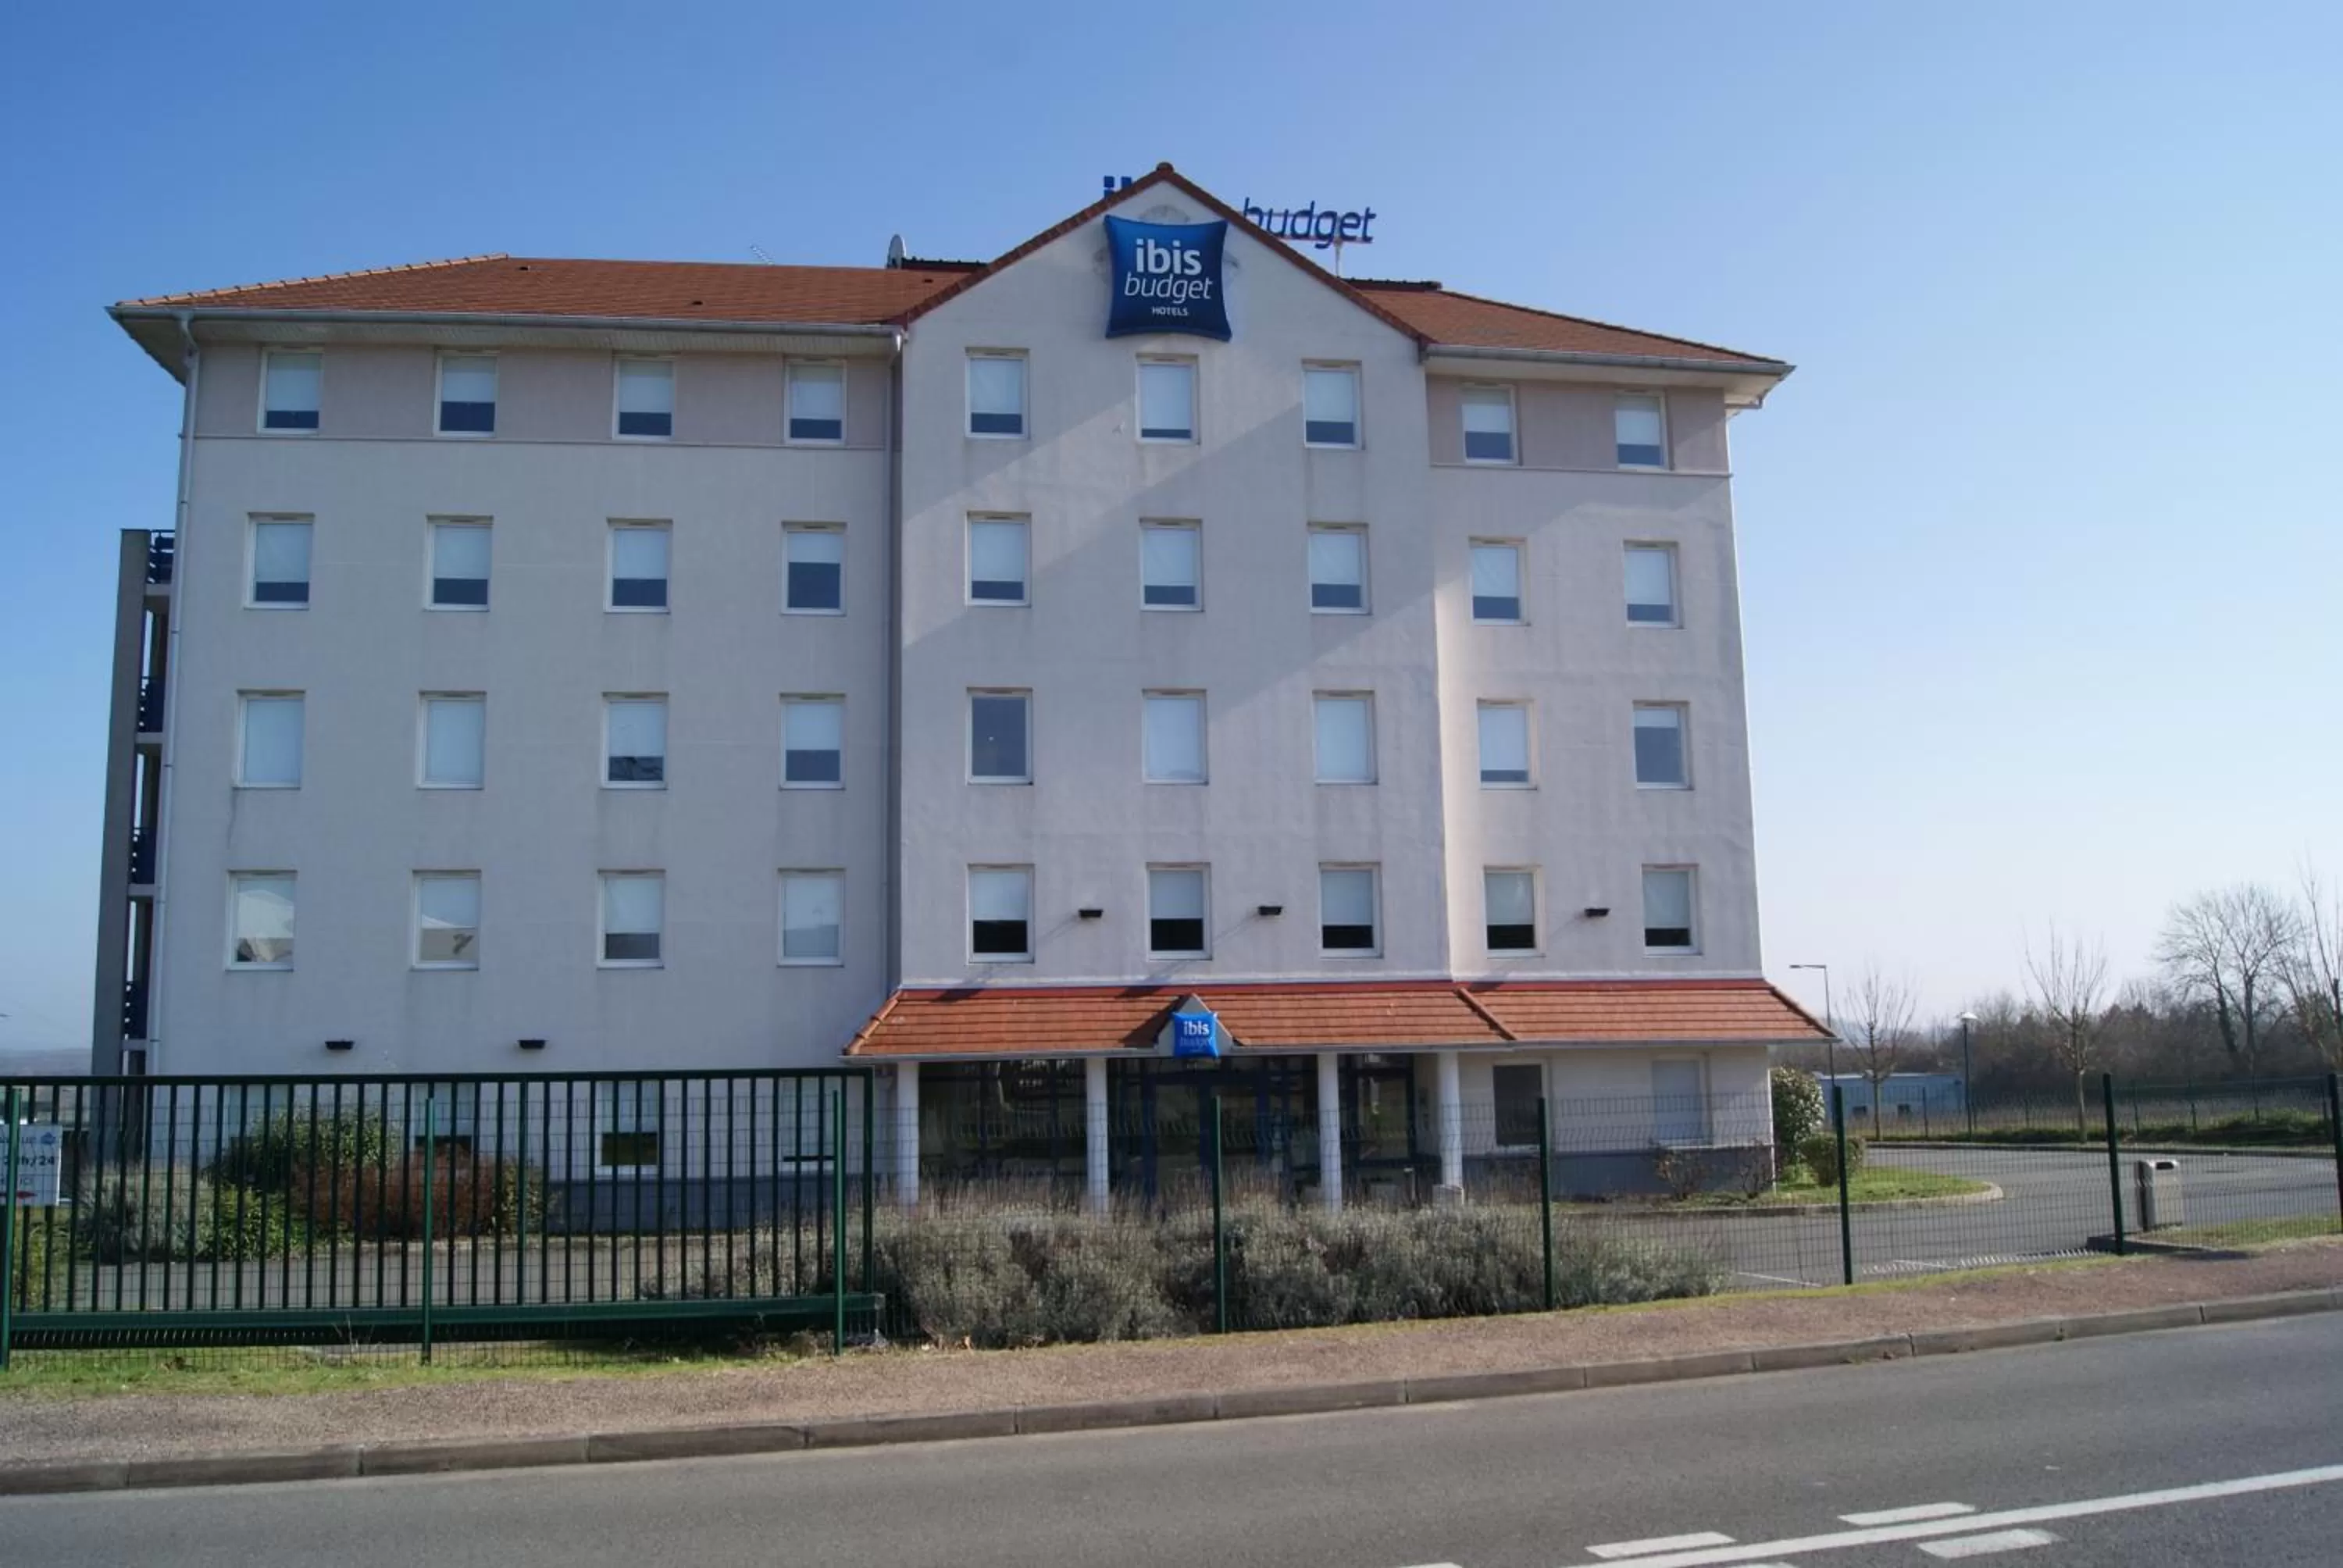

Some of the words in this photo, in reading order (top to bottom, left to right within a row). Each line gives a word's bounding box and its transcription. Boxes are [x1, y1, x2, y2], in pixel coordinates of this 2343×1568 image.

[1136, 237, 1203, 276] ibis
[1124, 271, 1214, 304] budget
[1152, 306, 1189, 316] HOTELS
[1183, 1020, 1210, 1035] ibis
